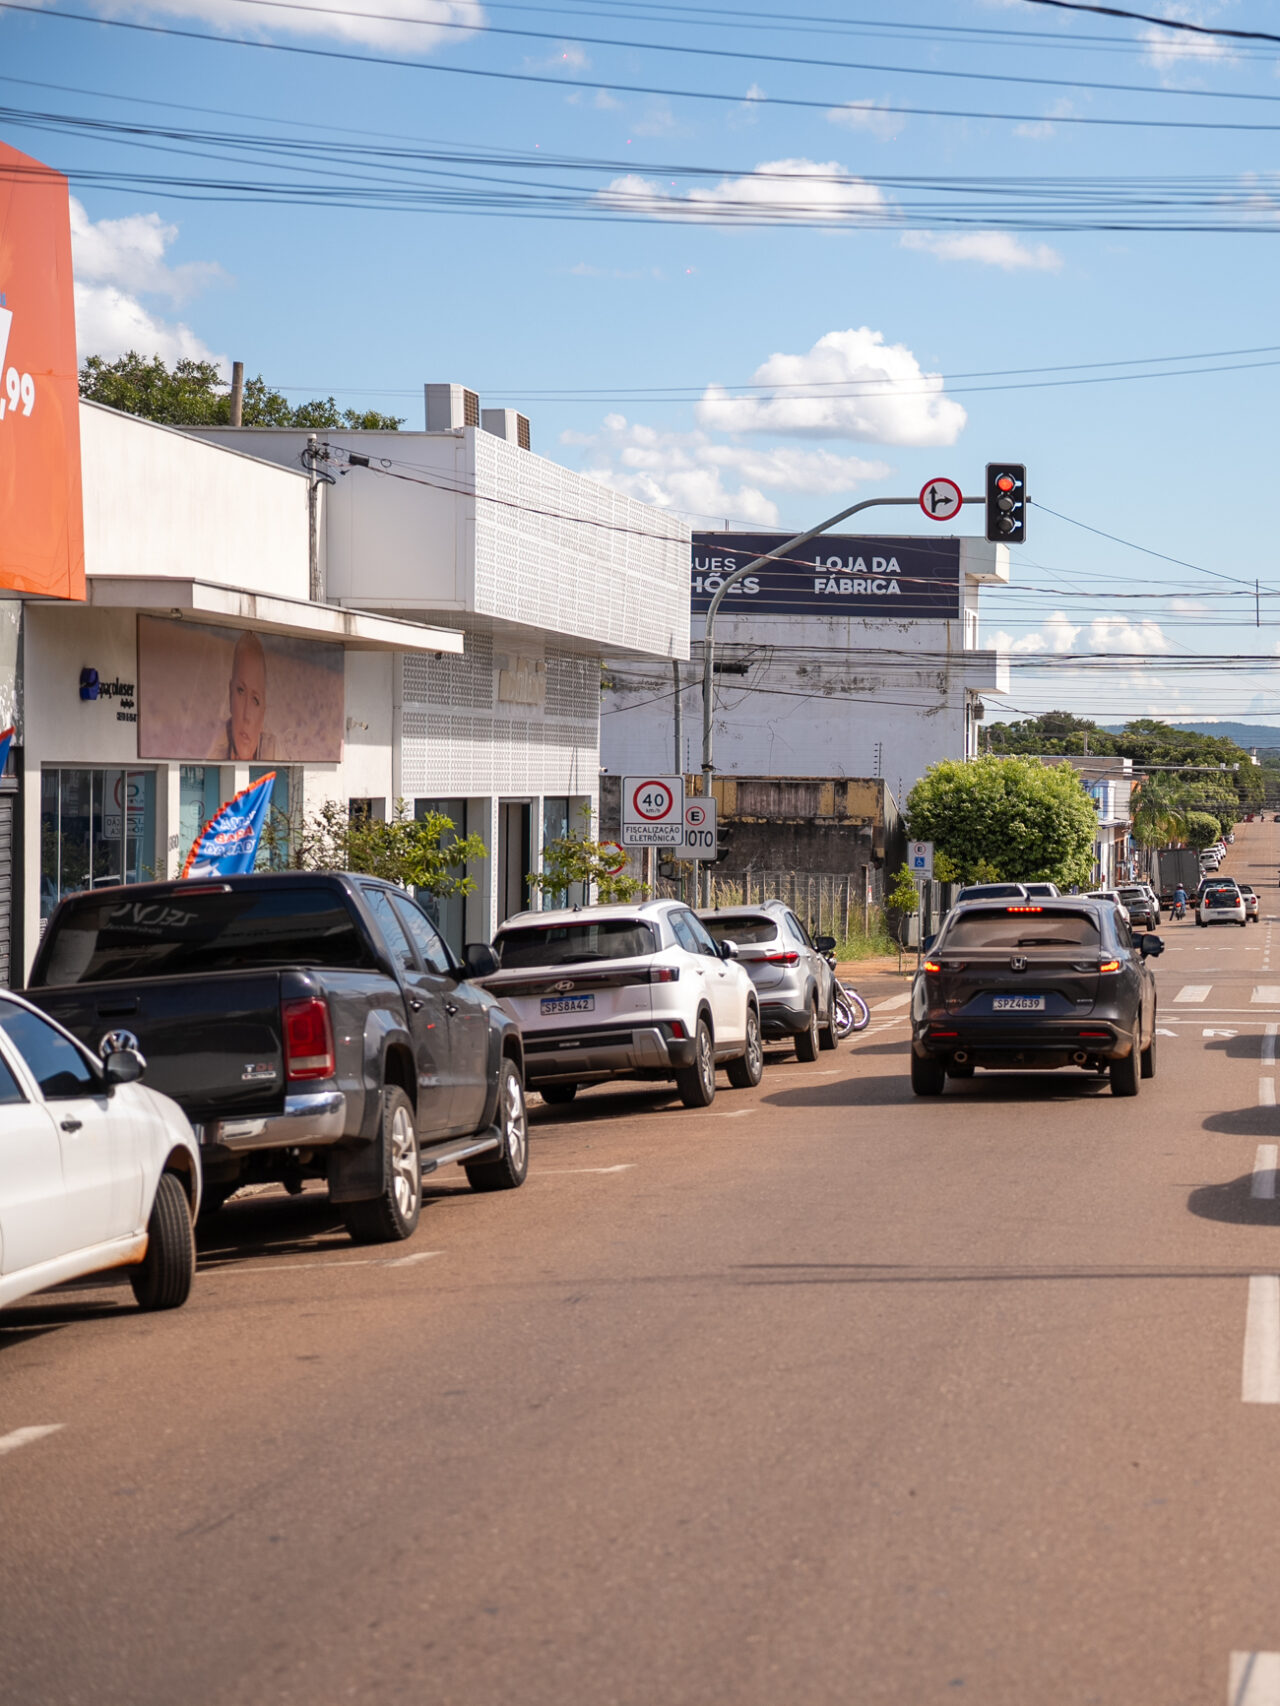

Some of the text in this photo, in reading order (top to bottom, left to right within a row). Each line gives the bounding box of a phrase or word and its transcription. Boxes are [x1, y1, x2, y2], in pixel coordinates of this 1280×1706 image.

[815, 556, 901, 573] LOJA DA
[814, 573, 901, 595] FÁBRICA
[643, 793, 664, 807] 40
[691, 811, 700, 821] E
[626, 825, 680, 836] FISCALIZAÇÃO
[630, 834, 676, 842] ELETRÔNICA
[685, 830, 714, 848] OTO
[545, 1000, 589, 1013] SPS8A42
[997, 999, 1040, 1009] SPZ4G39
